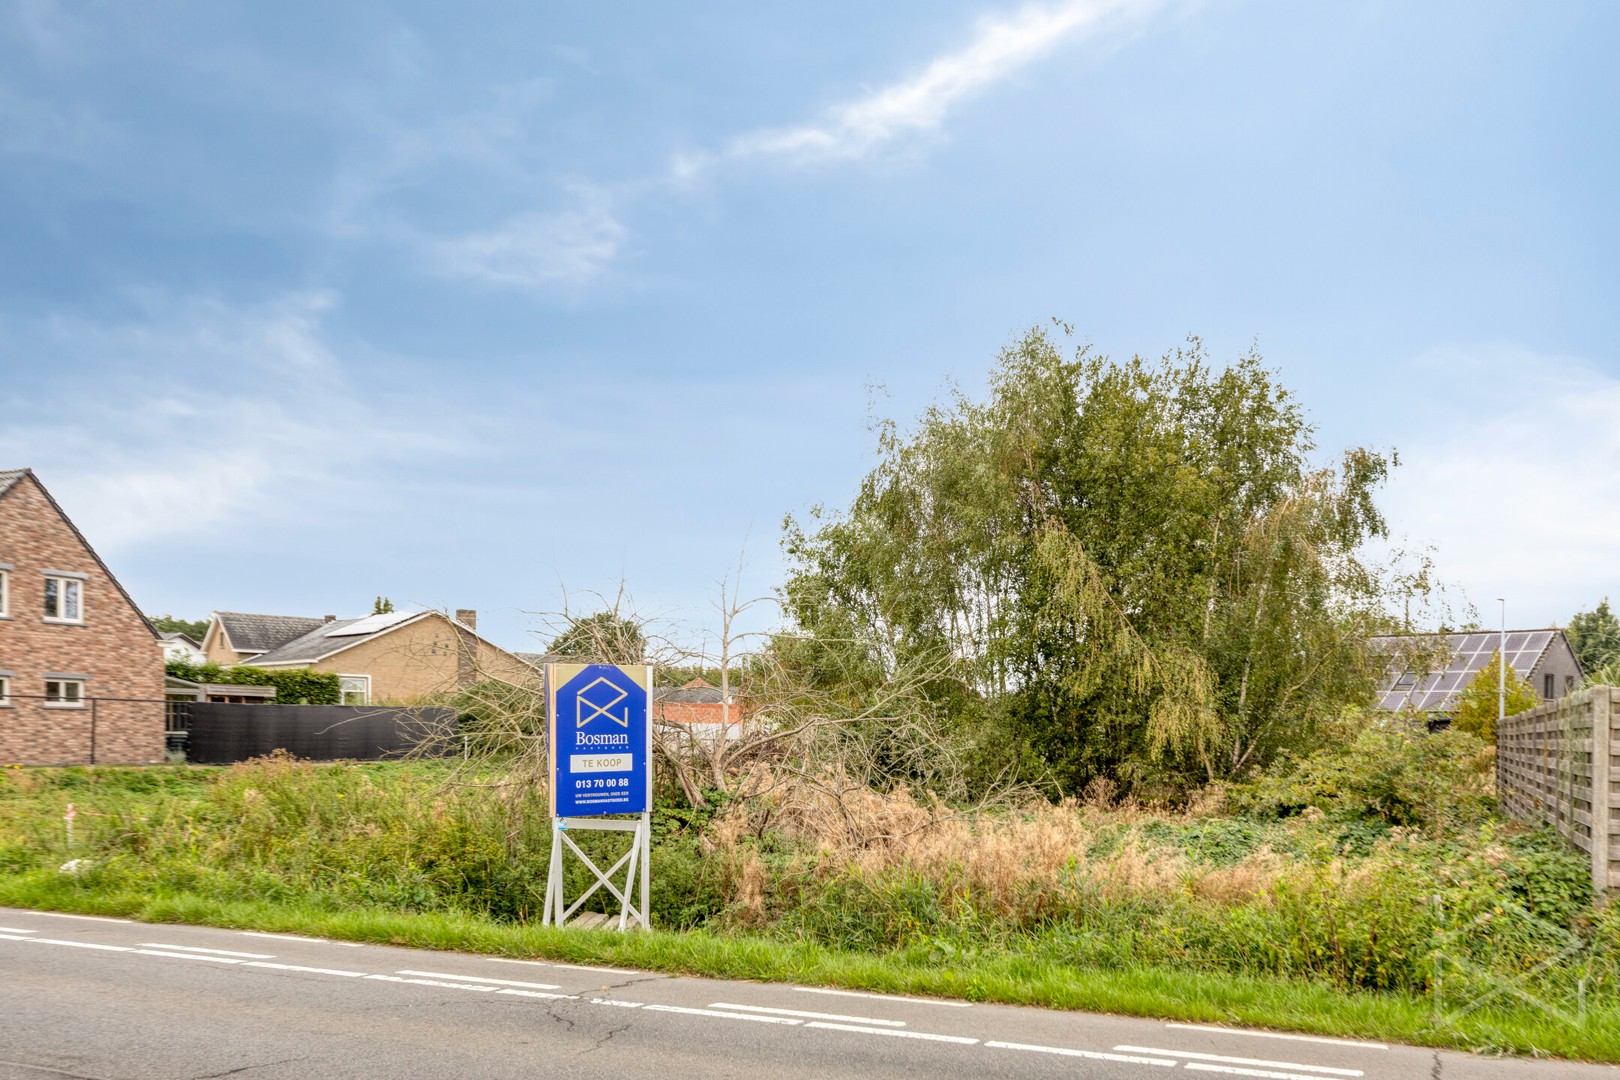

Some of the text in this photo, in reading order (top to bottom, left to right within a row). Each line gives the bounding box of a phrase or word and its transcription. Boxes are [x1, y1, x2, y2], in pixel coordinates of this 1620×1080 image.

[576, 731, 629, 745] Bosman
[582, 758, 622, 768] TE KOOP
[575, 778, 629, 788] 013 70 00 88
